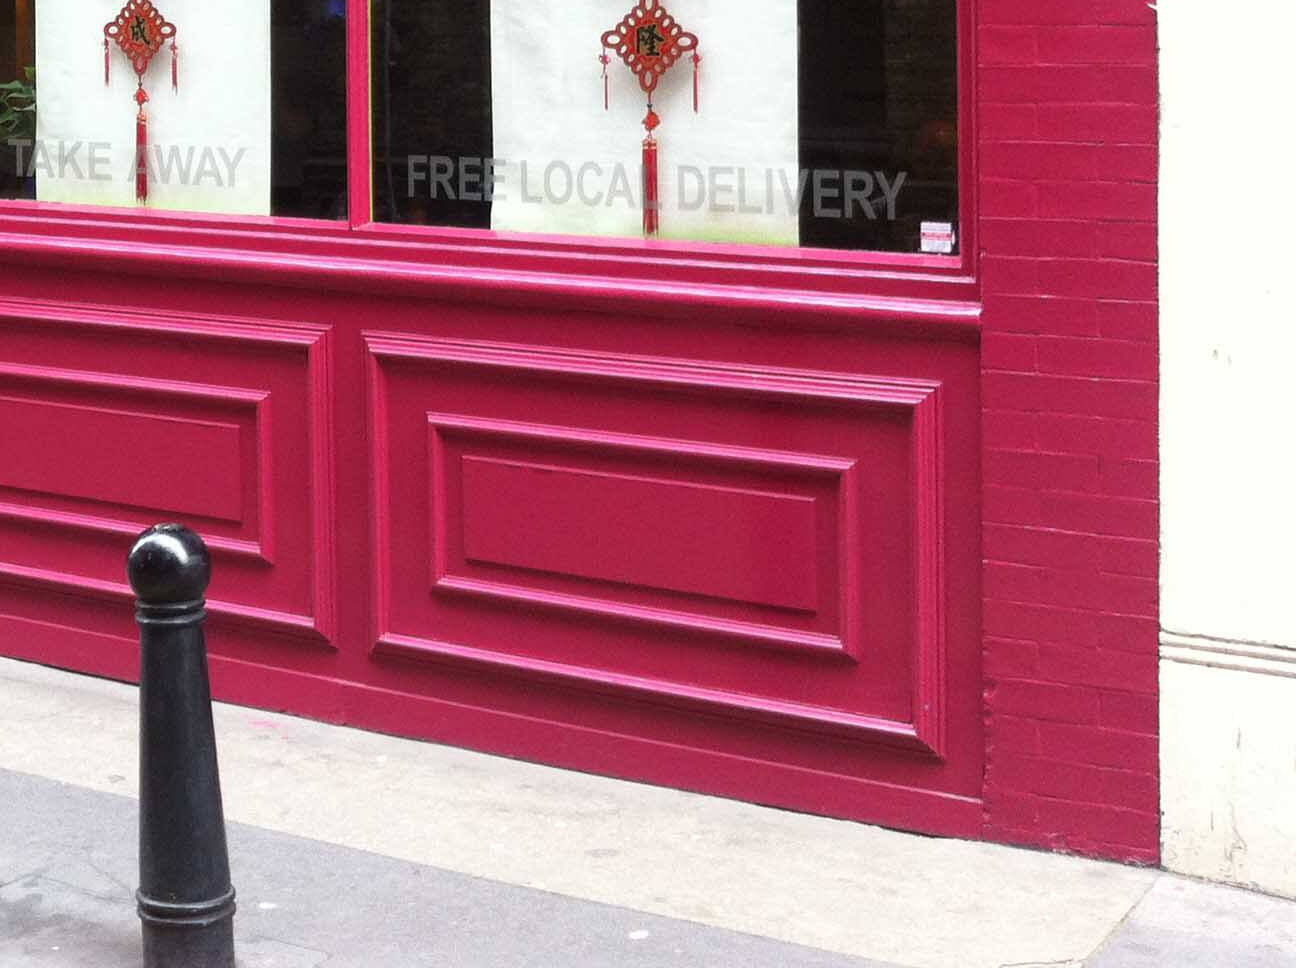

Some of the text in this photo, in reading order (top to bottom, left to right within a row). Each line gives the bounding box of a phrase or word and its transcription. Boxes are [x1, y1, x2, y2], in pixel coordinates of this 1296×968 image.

[8, 139, 112, 180] TAKE
[128, 144, 247, 187] AWAY
[407, 154, 907, 221] FREE LOCAL DELIVERY
